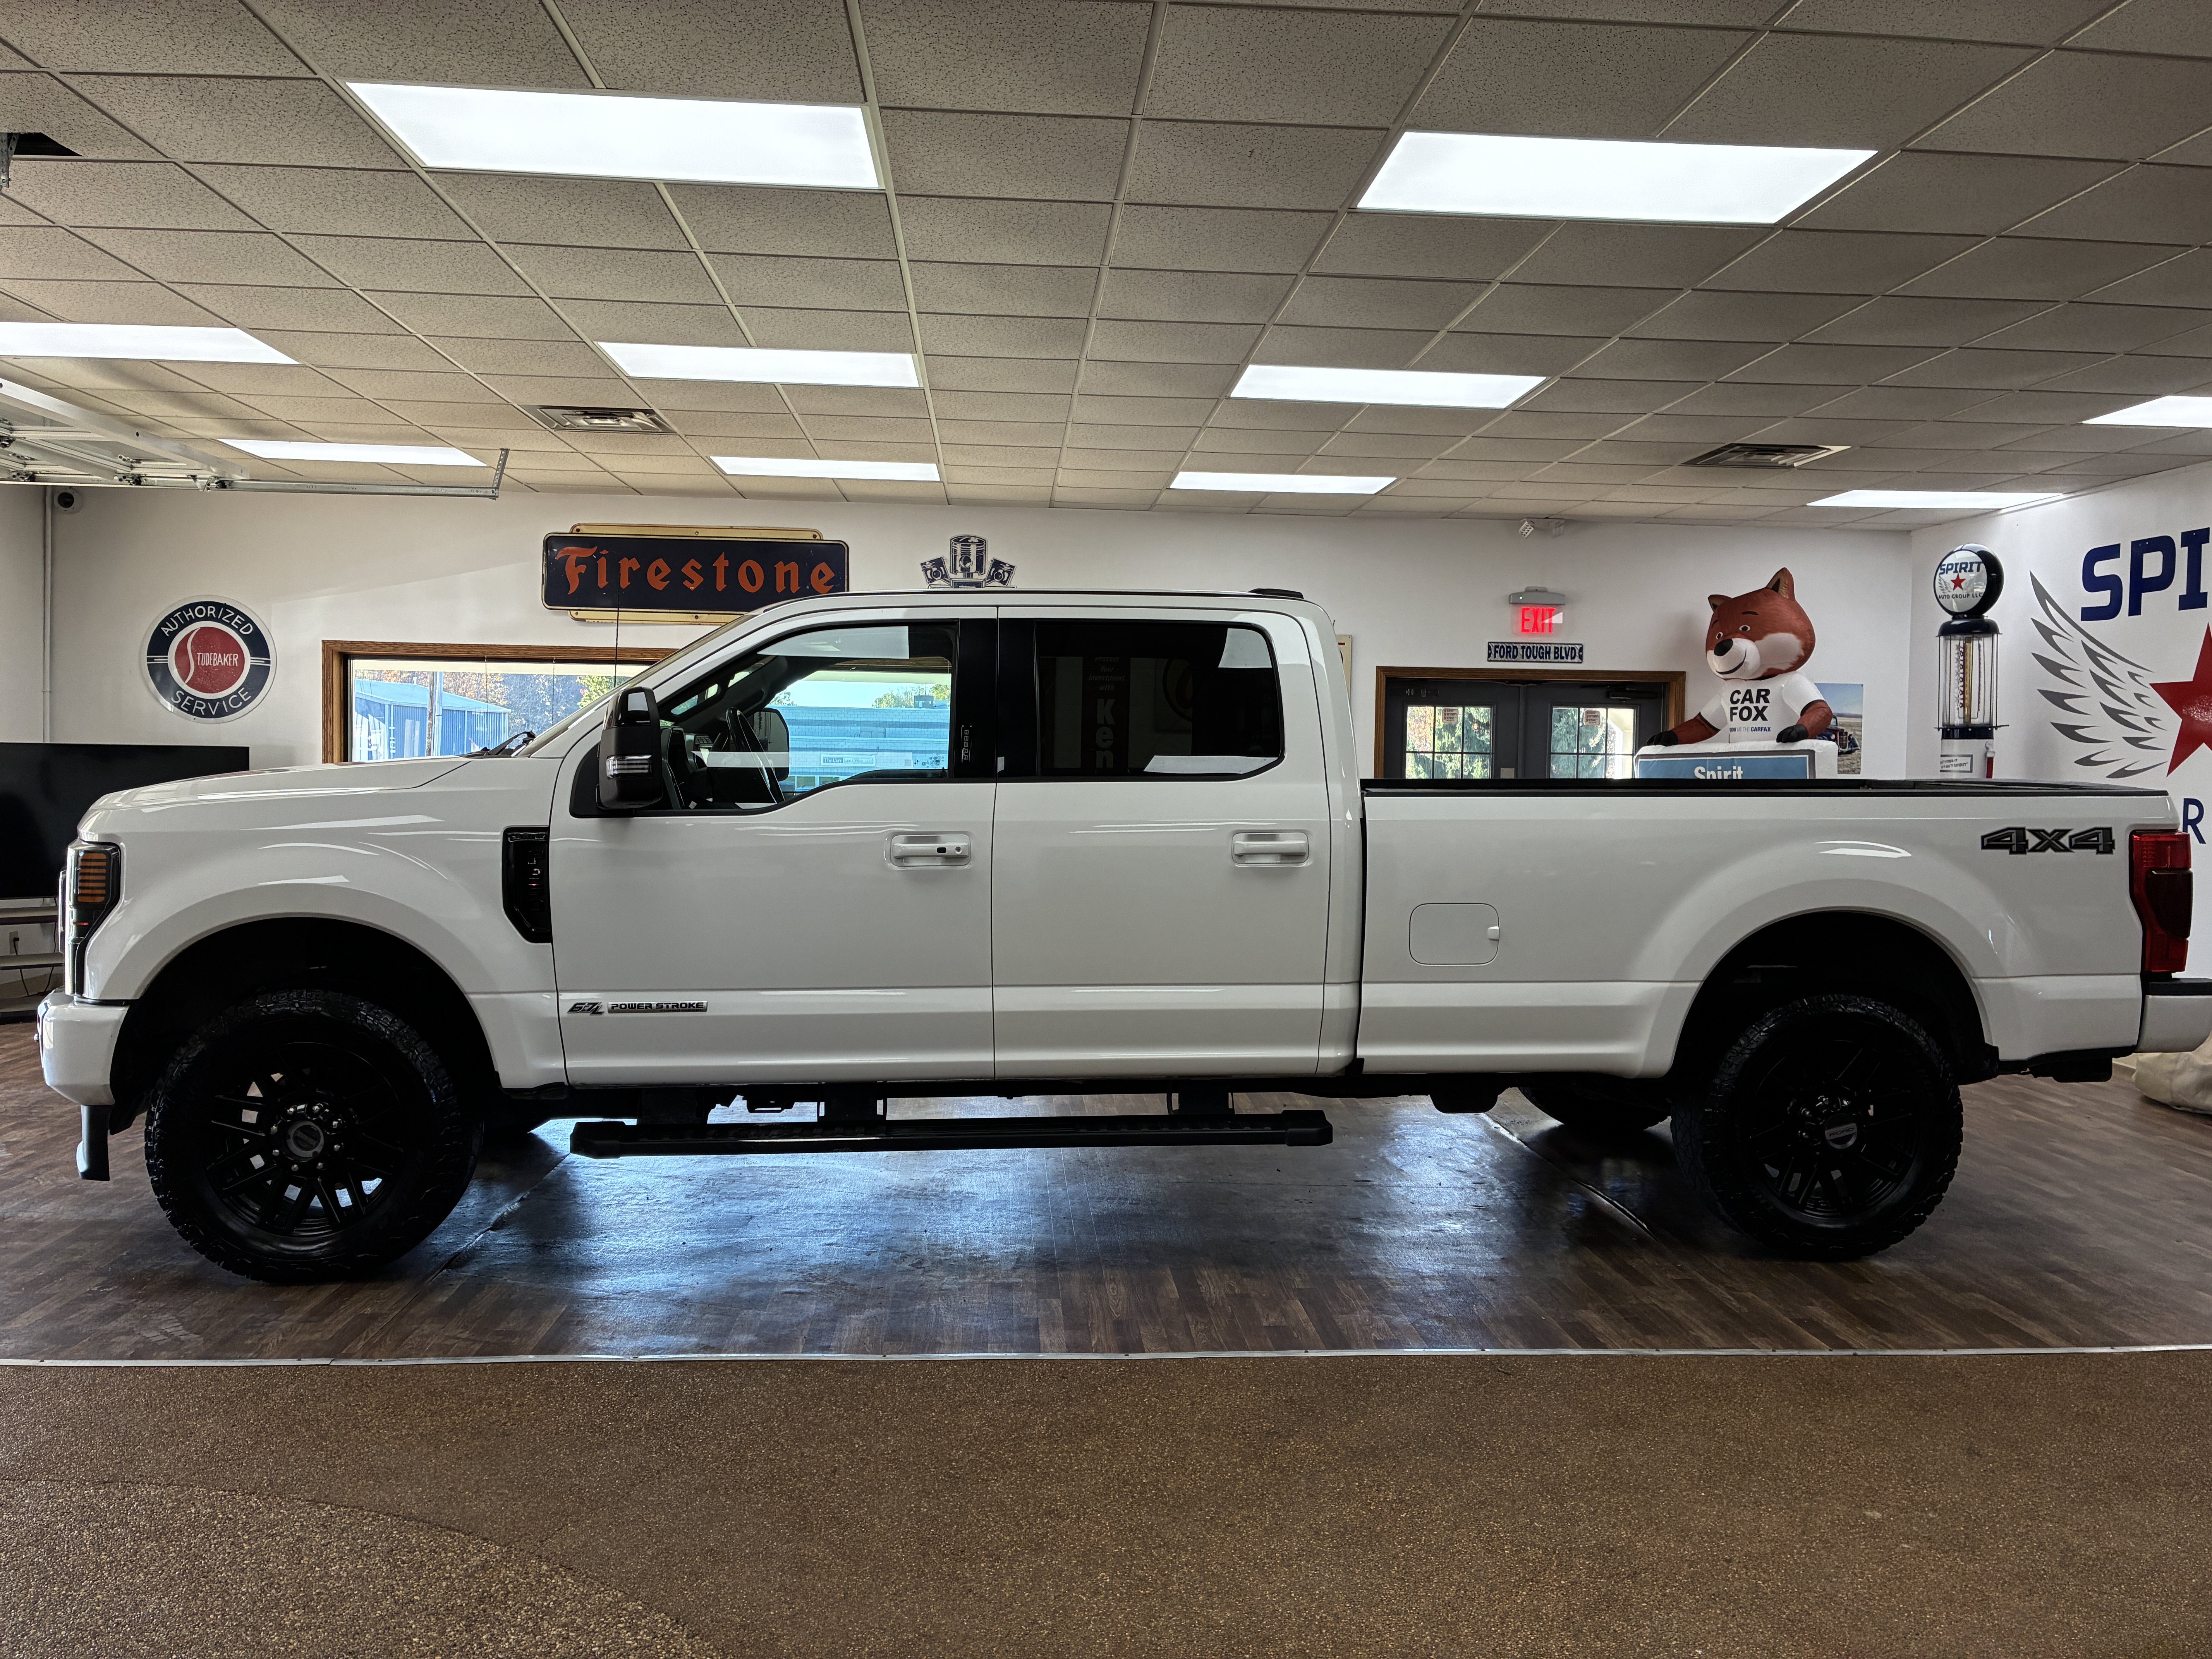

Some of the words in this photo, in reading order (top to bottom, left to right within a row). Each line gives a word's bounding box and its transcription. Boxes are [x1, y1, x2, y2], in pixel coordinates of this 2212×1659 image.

[556, 546, 835, 595] Firestone
[1939, 562, 1982, 575] SPIRIT
[160, 605, 254, 637] AUTHORIZED
[1521, 607, 1556, 633] EXIT
[1494, 645, 1518, 659] FORD
[1521, 645, 1551, 660] TOUGH
[1554, 646, 1577, 660] BLVD
[171, 687, 252, 715] SERVICE
[1730, 689, 1771, 705] CAR
[1730, 706, 1769, 722] FOX
